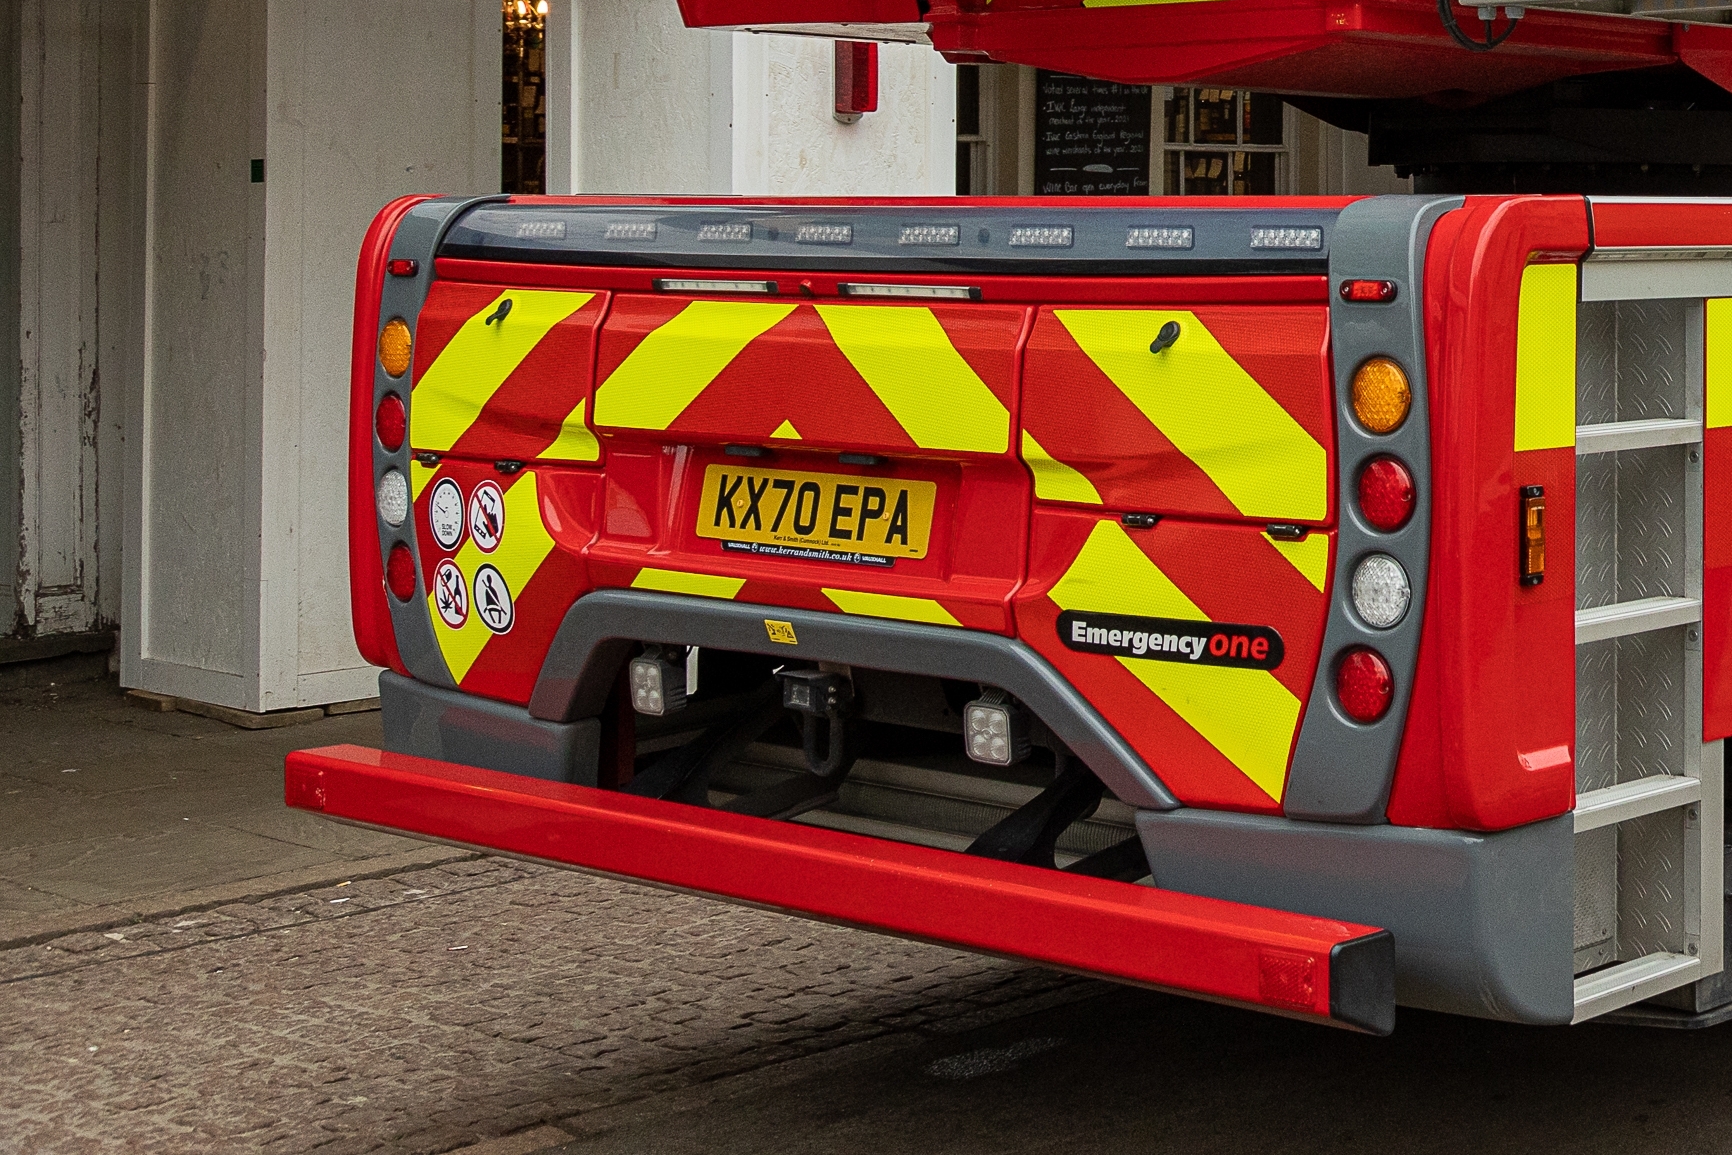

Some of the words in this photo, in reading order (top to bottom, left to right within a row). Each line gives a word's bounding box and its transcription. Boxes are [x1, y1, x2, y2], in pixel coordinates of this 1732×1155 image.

[713, 474, 821, 536] KX70
[828, 484, 909, 546] EPA
[759, 546, 852, 562] www.kerrandsmith.co.uk
